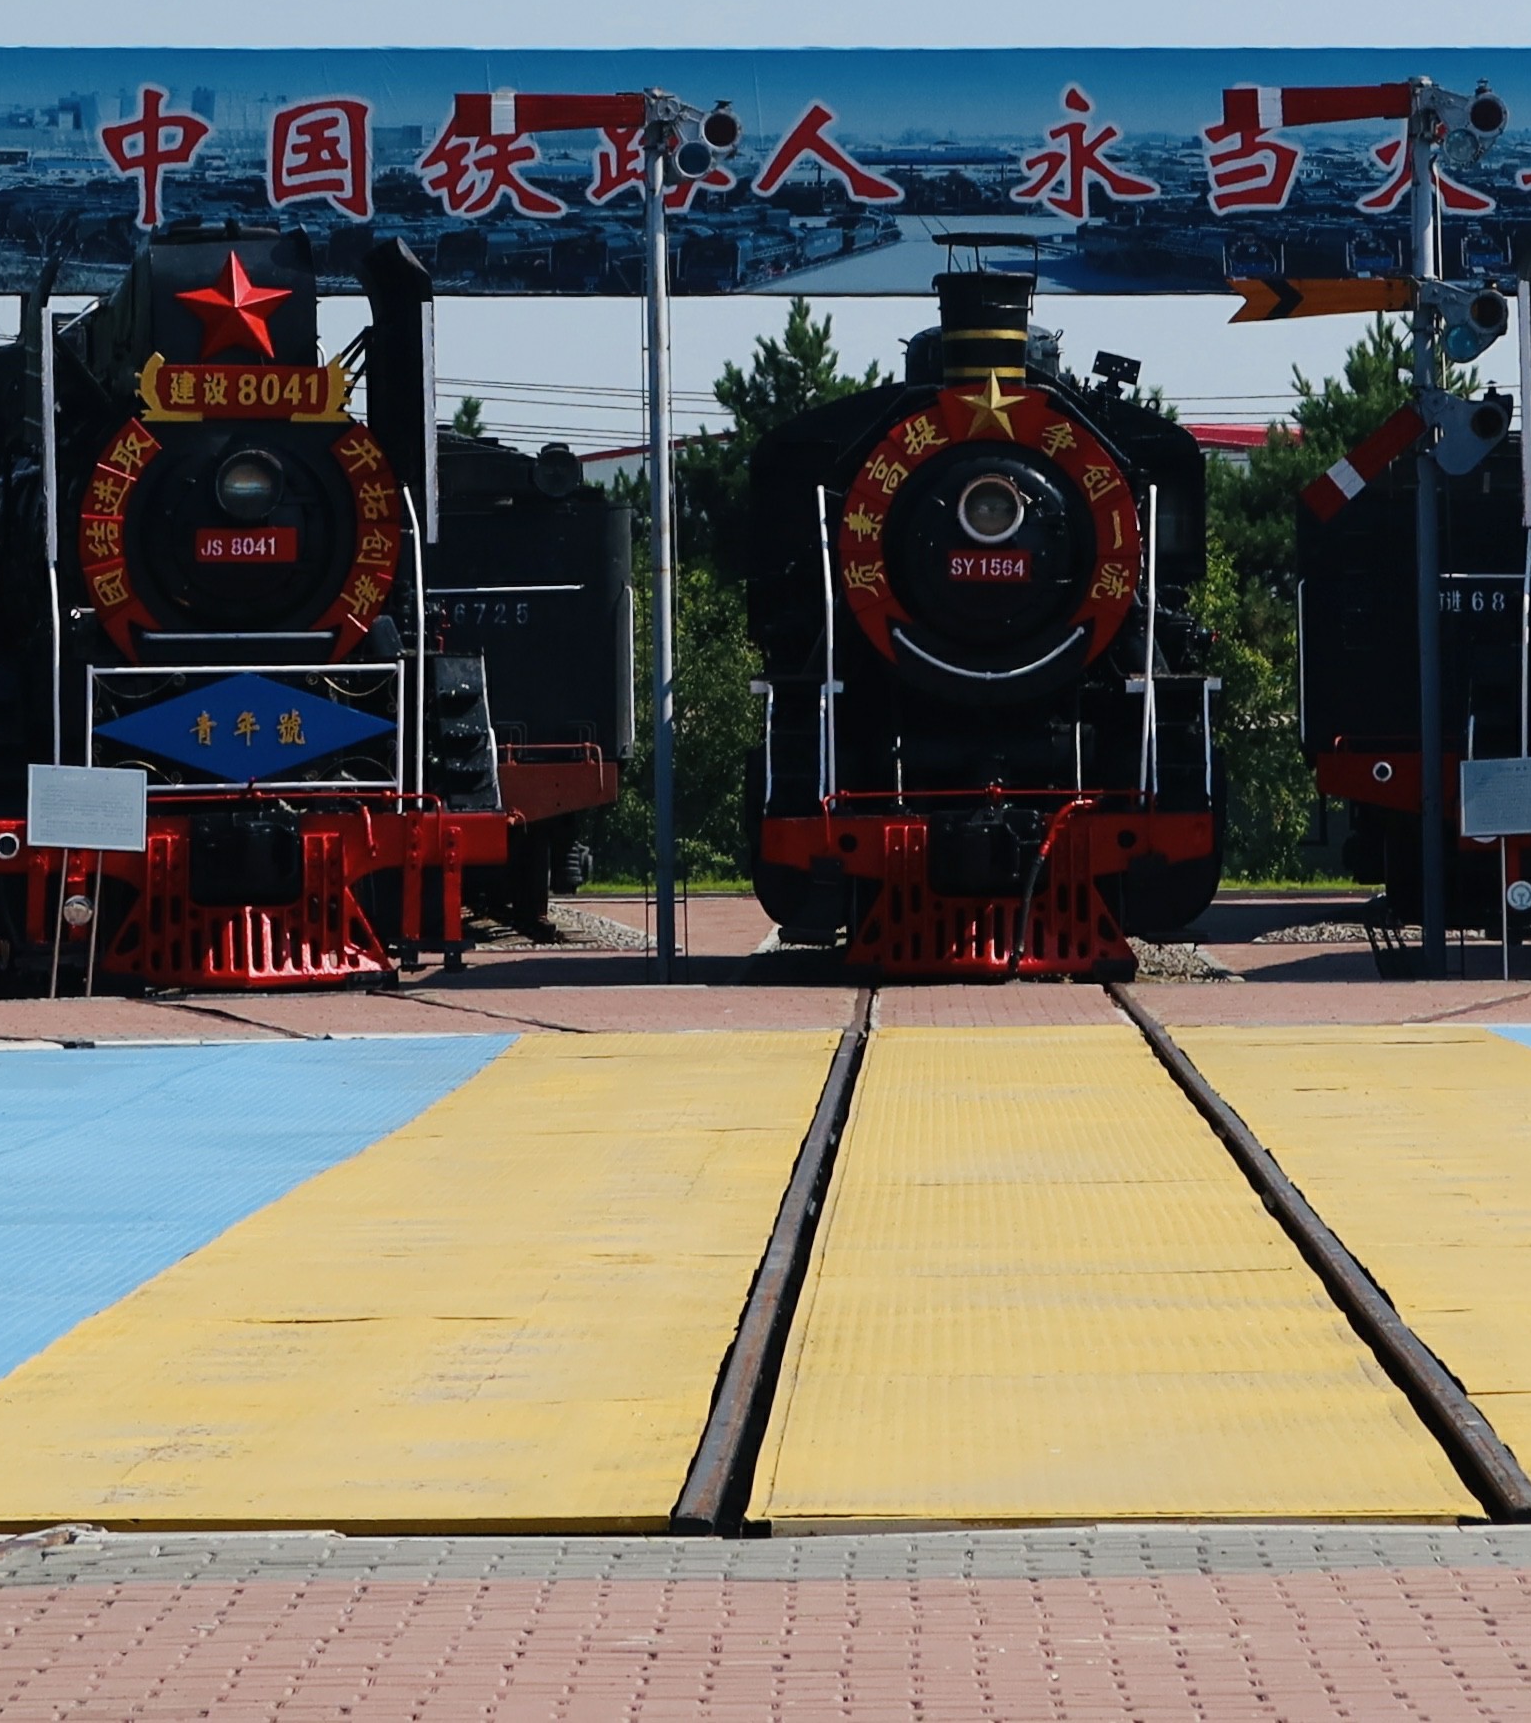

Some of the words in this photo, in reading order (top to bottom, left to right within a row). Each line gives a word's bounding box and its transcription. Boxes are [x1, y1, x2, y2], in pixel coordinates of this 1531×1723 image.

[170, 373, 228, 406] 建设
[238, 374, 318, 405] 8041
[844, 415, 949, 597] 提高素质
[1042, 422, 1129, 599] 争创一流
[340, 438, 395, 614] 开拓创新
[201, 539, 223, 556] JS
[231, 537, 276, 555] 8041
[951, 558, 974, 575] SY
[980, 558, 1025, 576] 1564
[454, 602, 529, 624] 6725
